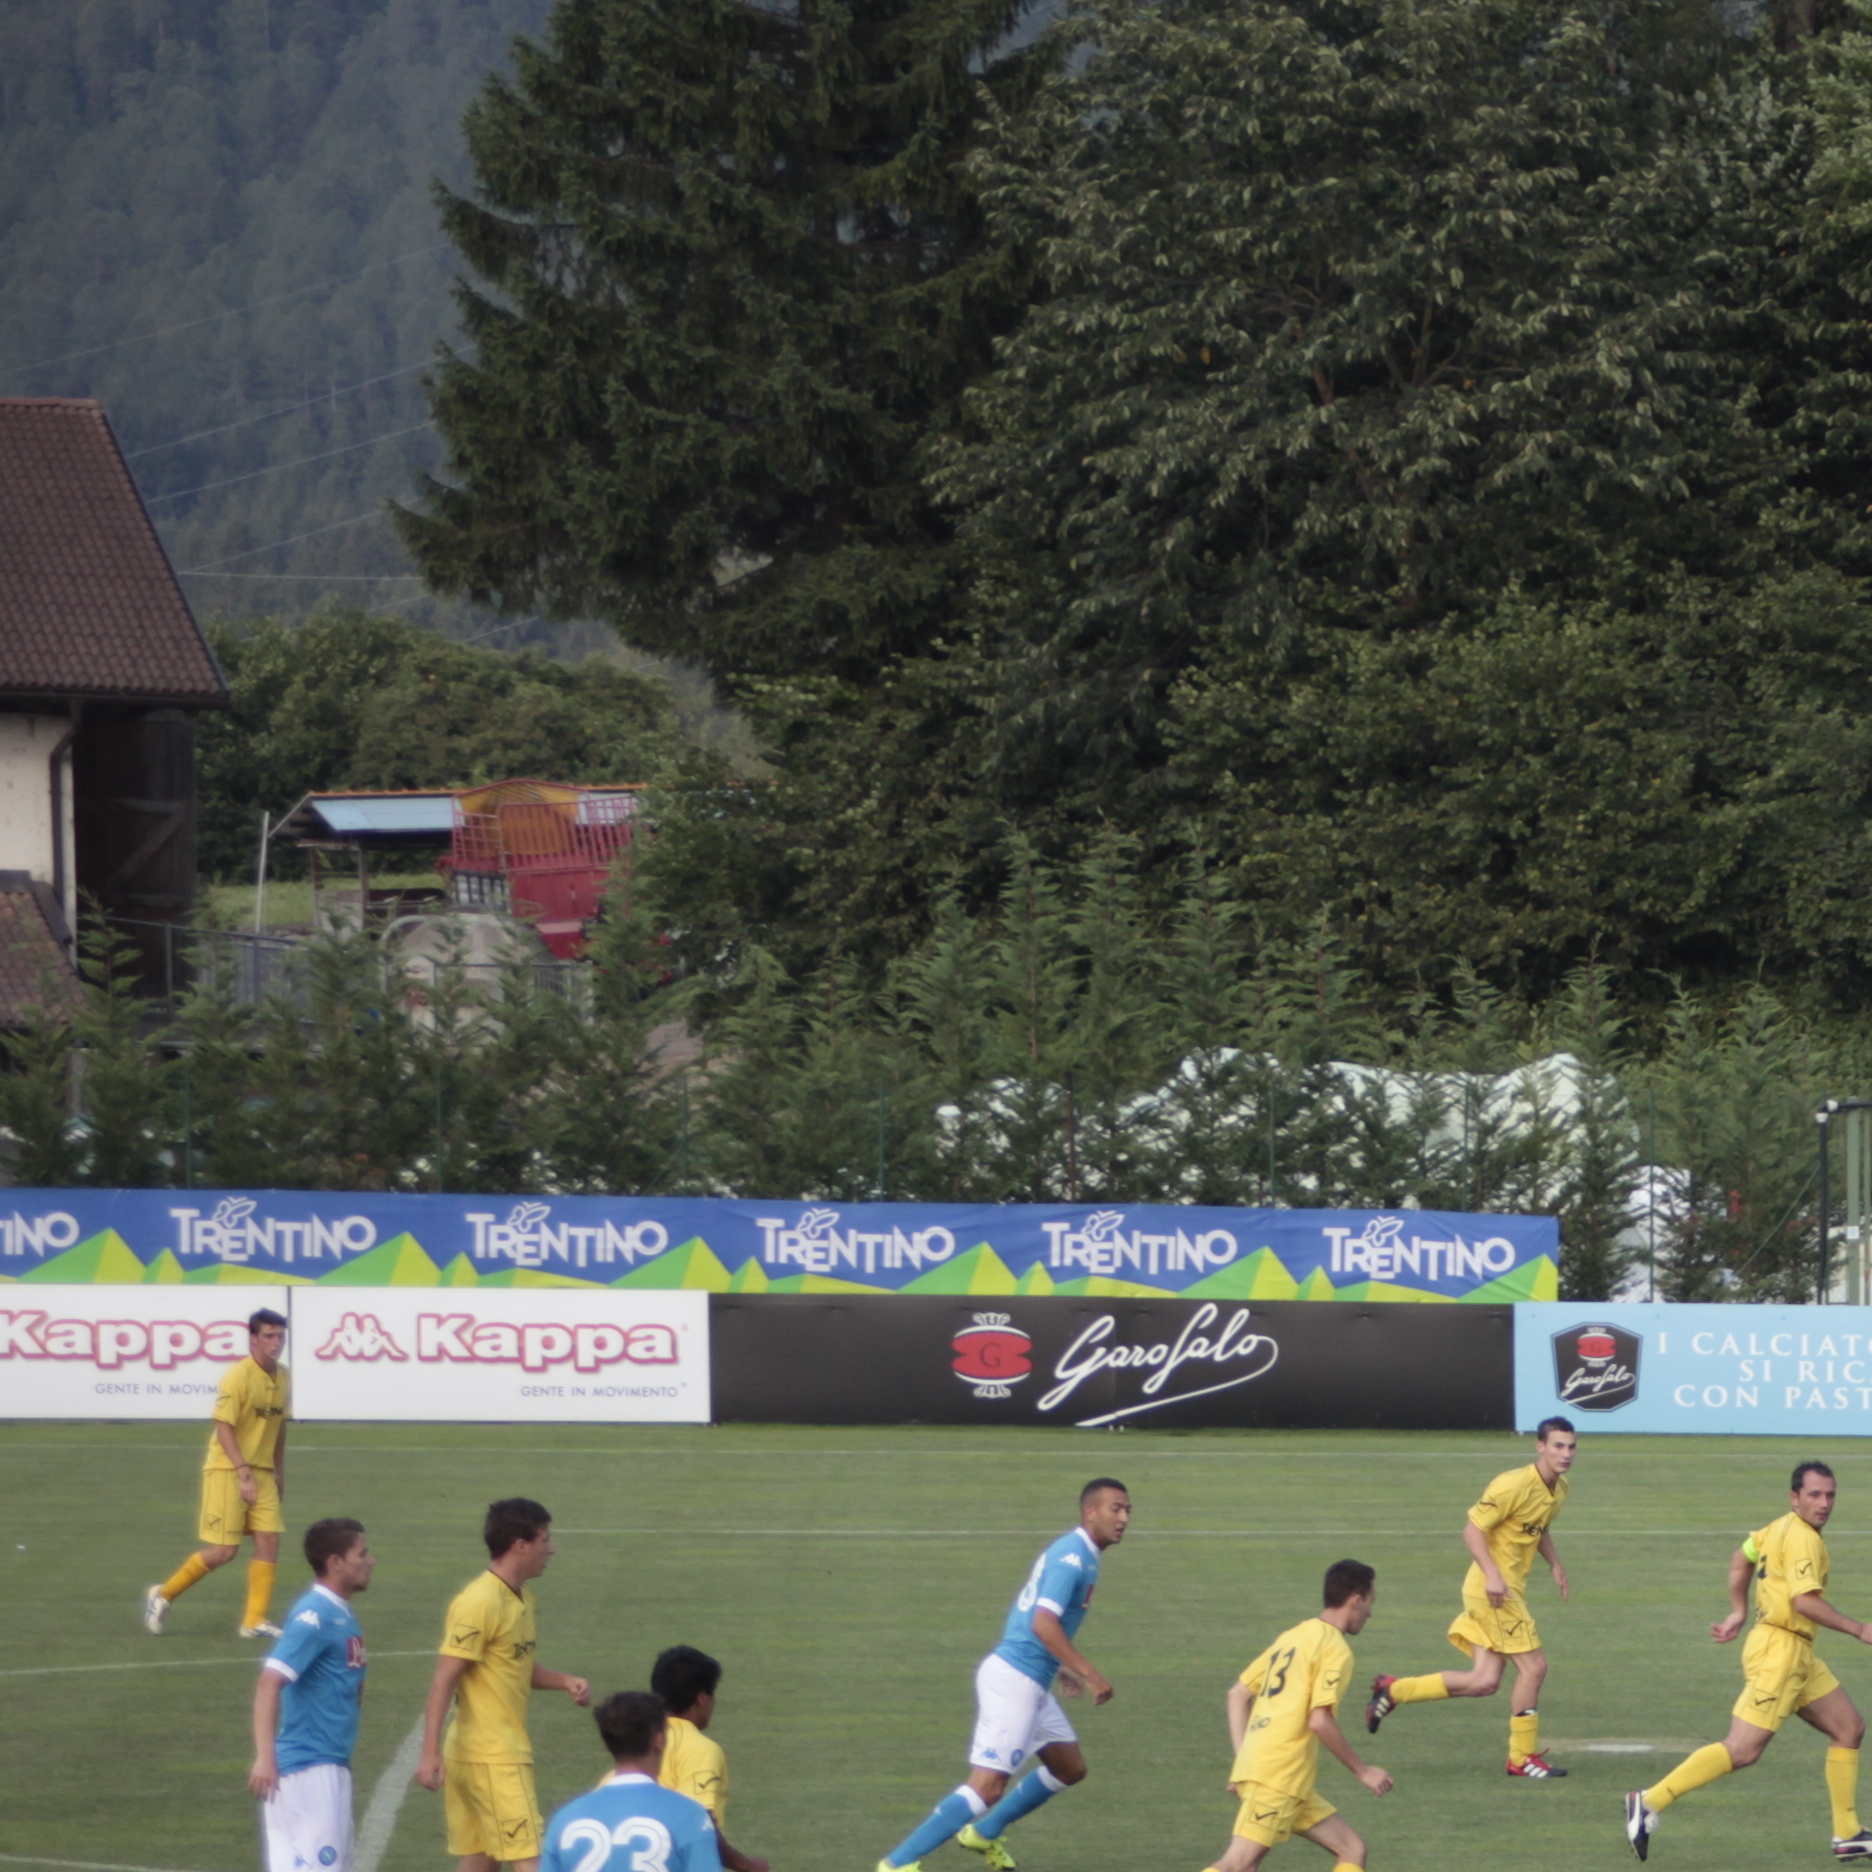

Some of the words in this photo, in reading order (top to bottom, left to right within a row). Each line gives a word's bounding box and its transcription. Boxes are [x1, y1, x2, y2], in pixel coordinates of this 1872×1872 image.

[169, 1207, 377, 1263] TRENTINO
[465, 1212, 669, 1268] TRENTINO
[755, 1217, 955, 1273] TRENTINO
[1041, 1221, 1238, 1276] TRENTINO
[1322, 1226, 1516, 1281] TRENTINO
[0, 1309, 251, 1371] Kappa
[417, 1312, 679, 1373] Kappa
[1037, 1302, 1279, 1428] Garofalo
[1657, 1331, 1668, 1354] I
[169, 1383, 219, 1395] MOVIM
[1673, 1383, 1760, 1409] CON
[1739, 1358, 1773, 1383] SI
